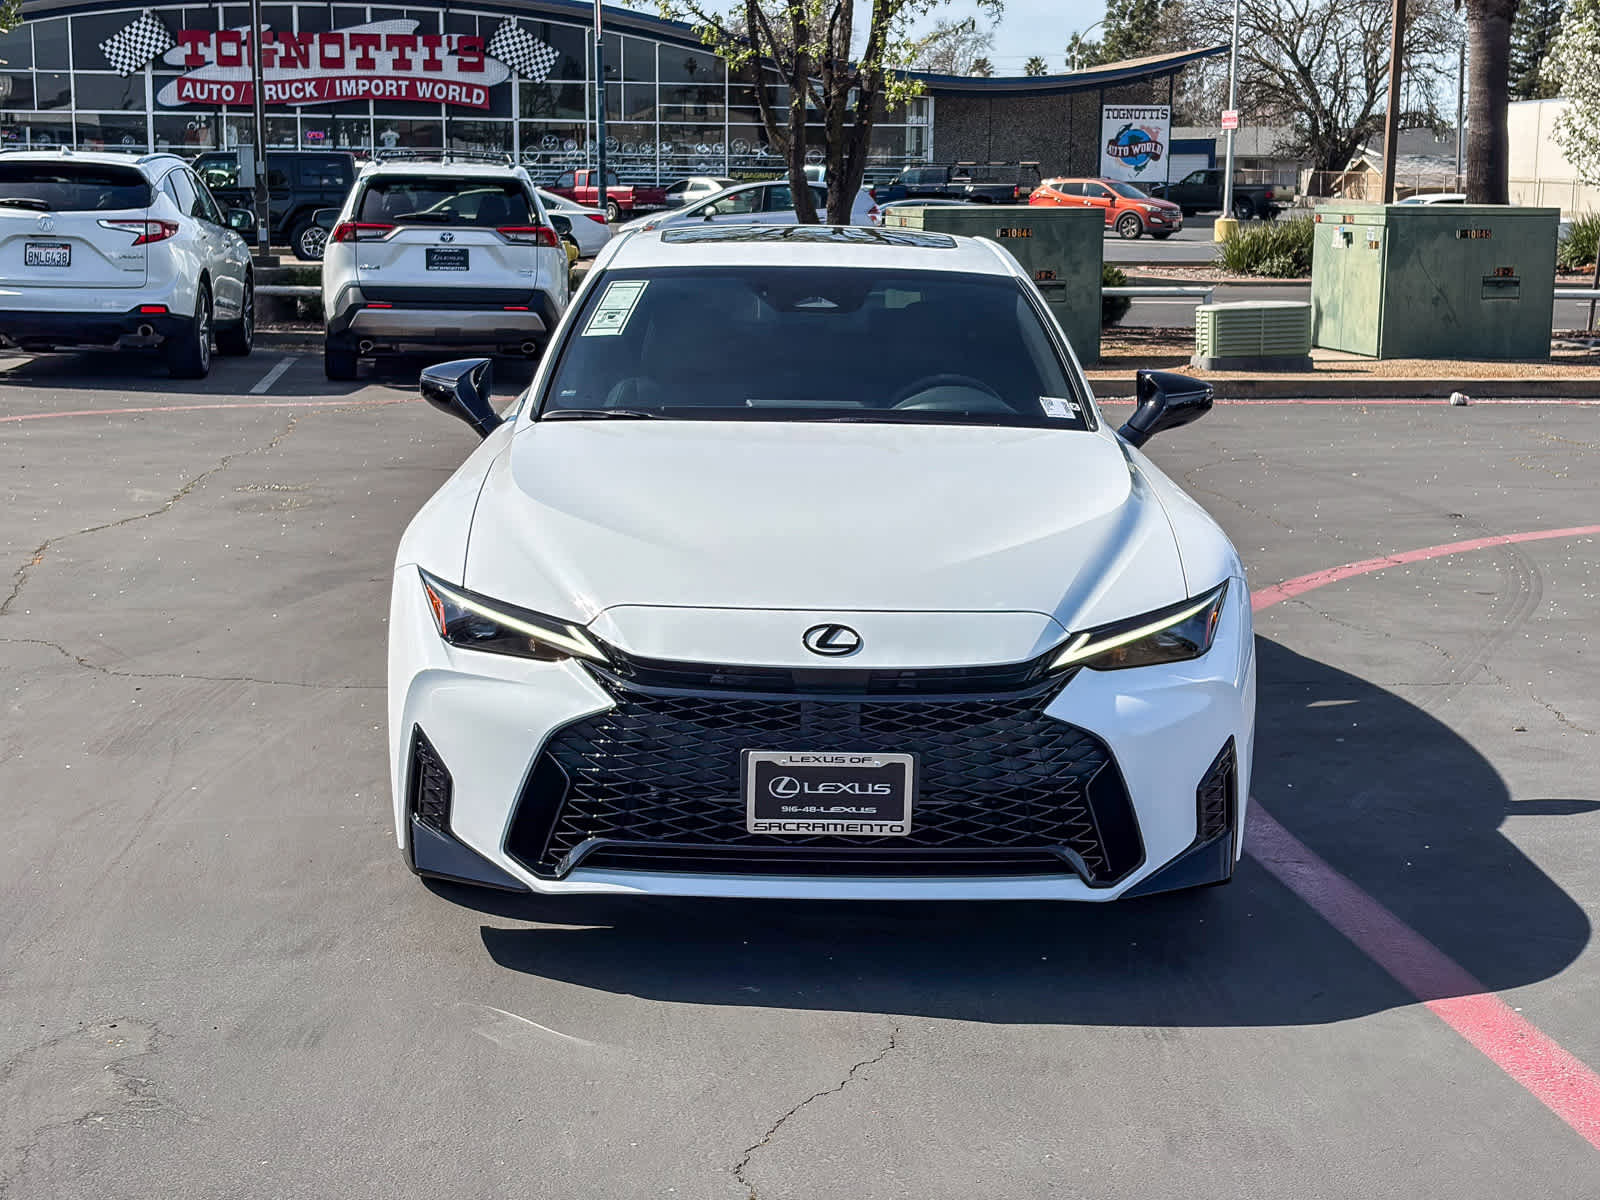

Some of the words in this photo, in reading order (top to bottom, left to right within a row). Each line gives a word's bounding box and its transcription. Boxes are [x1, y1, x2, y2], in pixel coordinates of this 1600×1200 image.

[177, 29, 485, 73] TOGNOTTI'S
[181, 81, 235, 101] AUTO
[252, 81, 318, 99] RUCK
[335, 79, 409, 97] IMPORT
[416, 82, 485, 105] WORLD
[1105, 107, 1169, 120] TOGNOTTI'S
[1131, 142, 1163, 156] WORLD
[789, 755, 846, 764] LEXUS
[849, 756, 873, 764] OF
[804, 782, 891, 796] LEXUS
[781, 805, 877, 814] 916-48-LEXUS
[753, 822, 905, 834] SACRAMENTO
